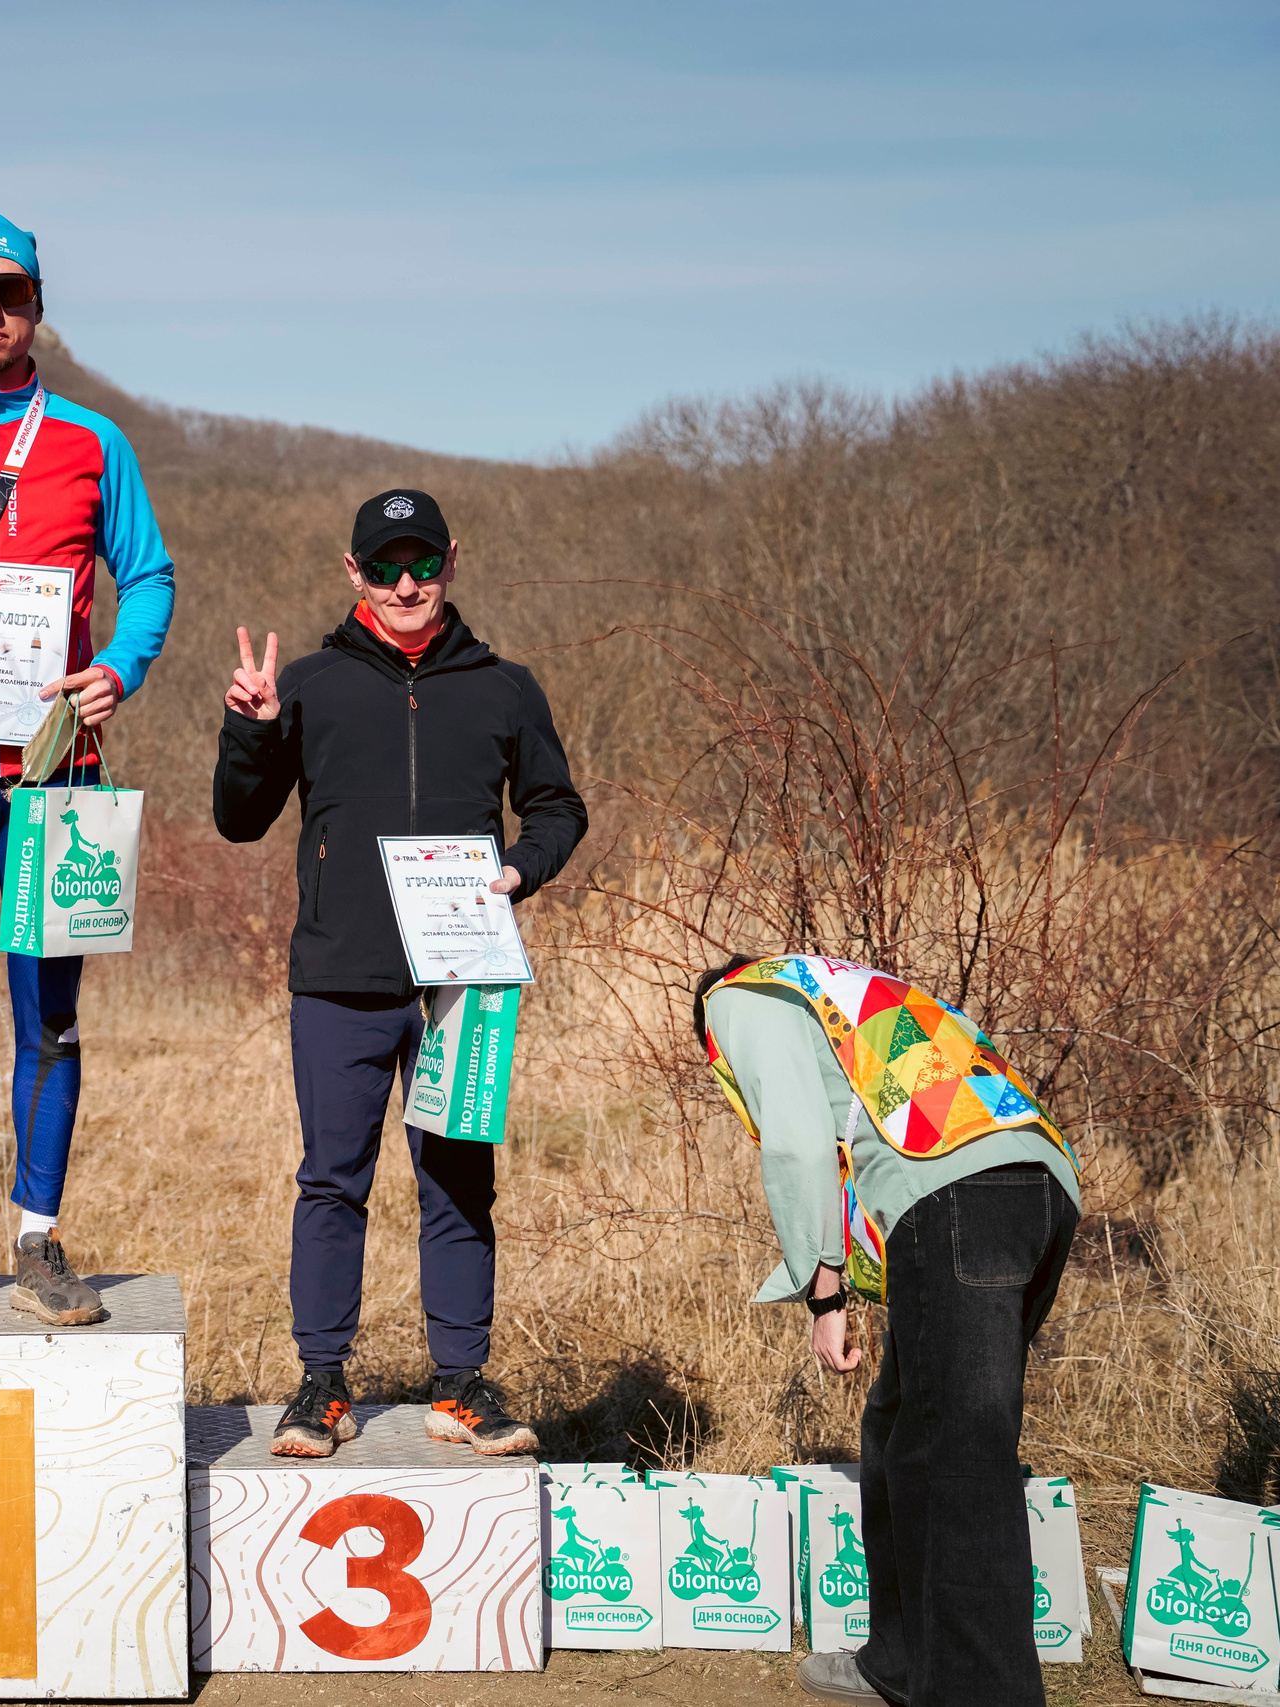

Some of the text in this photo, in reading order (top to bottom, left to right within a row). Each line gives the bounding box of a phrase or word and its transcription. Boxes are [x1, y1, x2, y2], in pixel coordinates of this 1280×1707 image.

[18, 406, 39, 449] ЛЕРМОНТОВ
[8, 483, 17, 537] RDSKI
[11, 837, 35, 948] ПОДПИШИСЬ
[54, 873, 120, 897] bionova
[405, 876, 488, 888] ГРАМОТА
[72, 916, 124, 931] ДНЯ ОСНОВА
[460, 1023, 483, 1135] ПОДПИШИСЬ
[480, 1028, 500, 1137] PUBLIC_BIONOVA
[298, 1493, 431, 1660] 3
[545, 1567, 631, 1591] bionova
[671, 1567, 760, 1592] bionova
[822, 1574, 869, 1597] bion
[570, 1611, 644, 1623] ДНЯ ОСНОВА
[697, 1611, 772, 1625] ДНЯ ОСНОВА
[1150, 1588, 1249, 1629] bionova
[1034, 1629, 1064, 1639] НОВА
[1175, 1638, 1259, 1665] ДНЯ ОСНОВА
